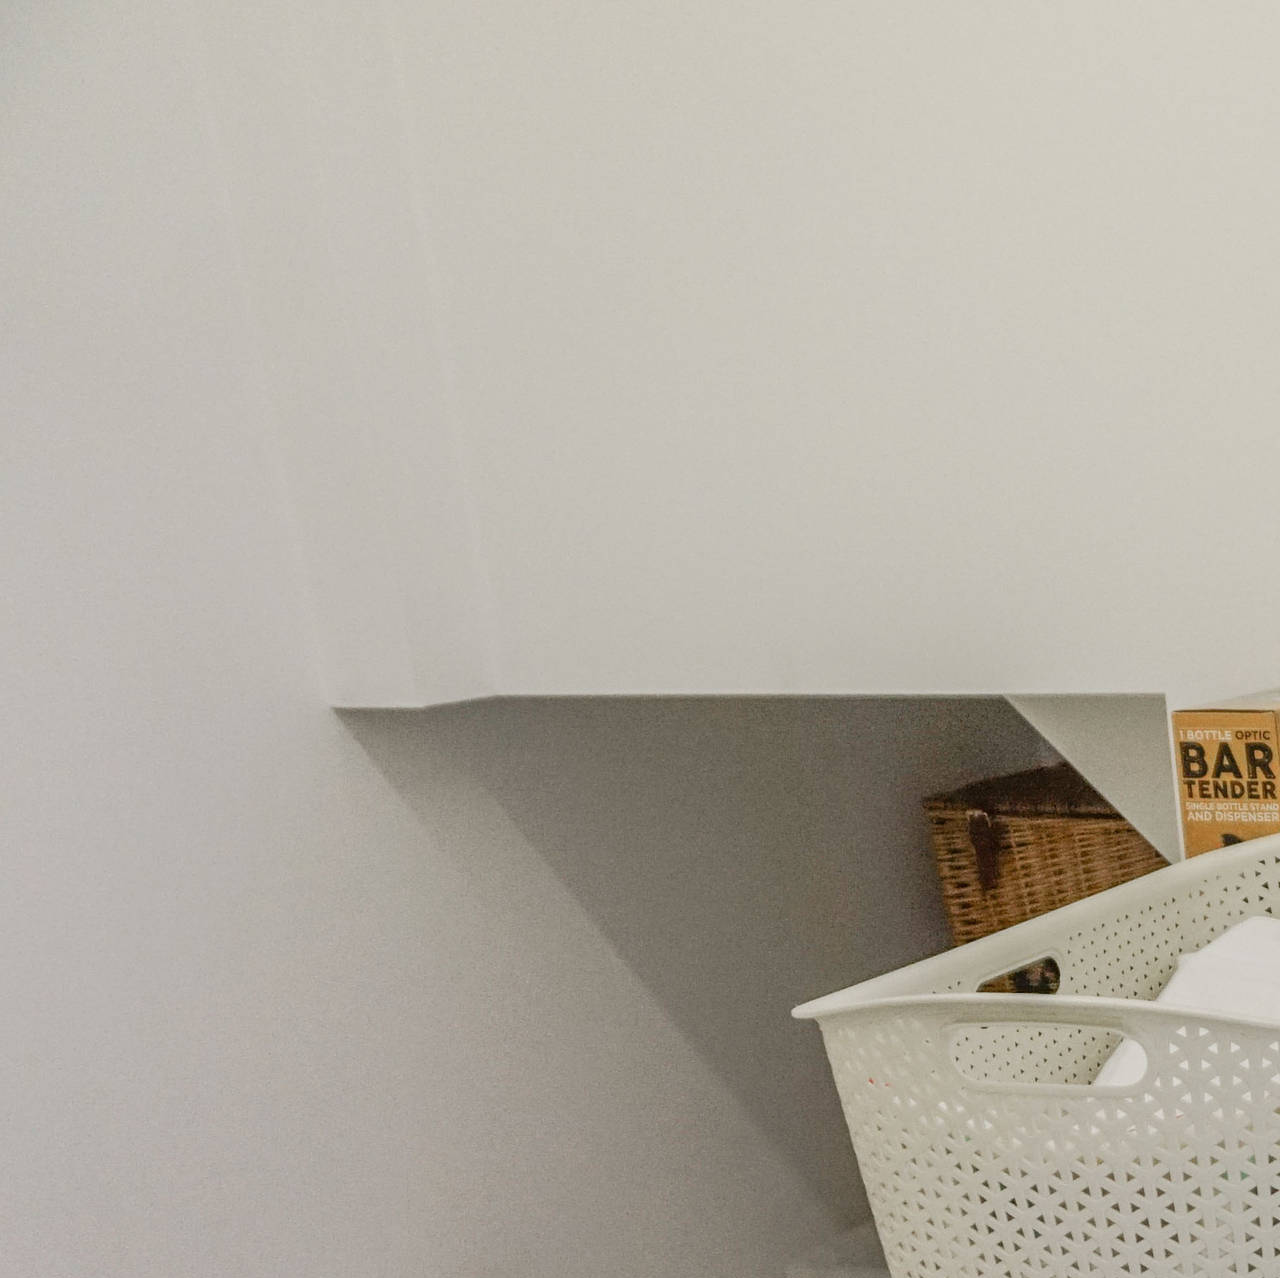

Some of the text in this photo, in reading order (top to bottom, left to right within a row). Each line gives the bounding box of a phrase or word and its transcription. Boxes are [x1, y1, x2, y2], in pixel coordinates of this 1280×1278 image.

[1187, 730, 1232, 740] BOTTLE
[1235, 730, 1270, 740] OPTIC
[1179, 741, 1276, 780] BAR
[1183, 780, 1277, 799] TENDER
[1186, 802, 1279, 811] SINGLE BOTTLE STAND
[1188, 811, 1279, 823] AND DISPENSER
